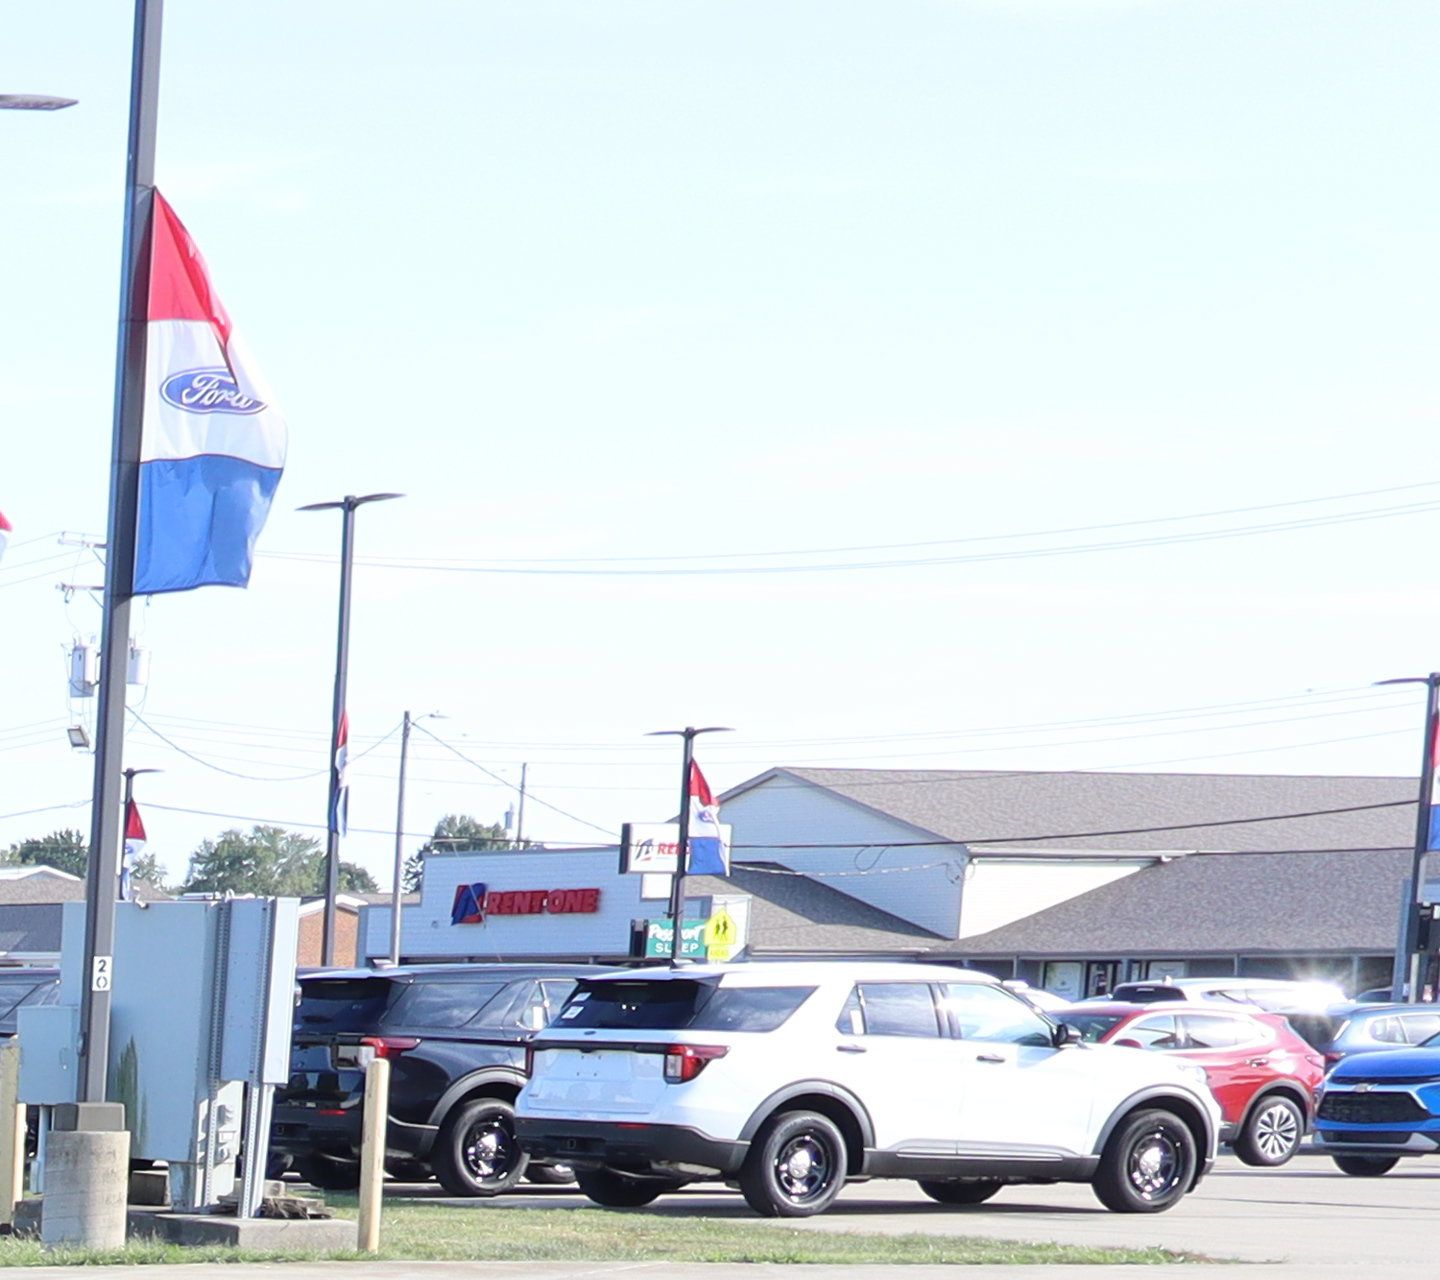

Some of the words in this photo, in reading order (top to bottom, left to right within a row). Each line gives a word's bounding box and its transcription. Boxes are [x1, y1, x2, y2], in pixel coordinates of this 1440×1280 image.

[487, 890, 548, 915] RENT
[548, 888, 601, 914] ONE
[655, 942, 699, 954] SLEP
